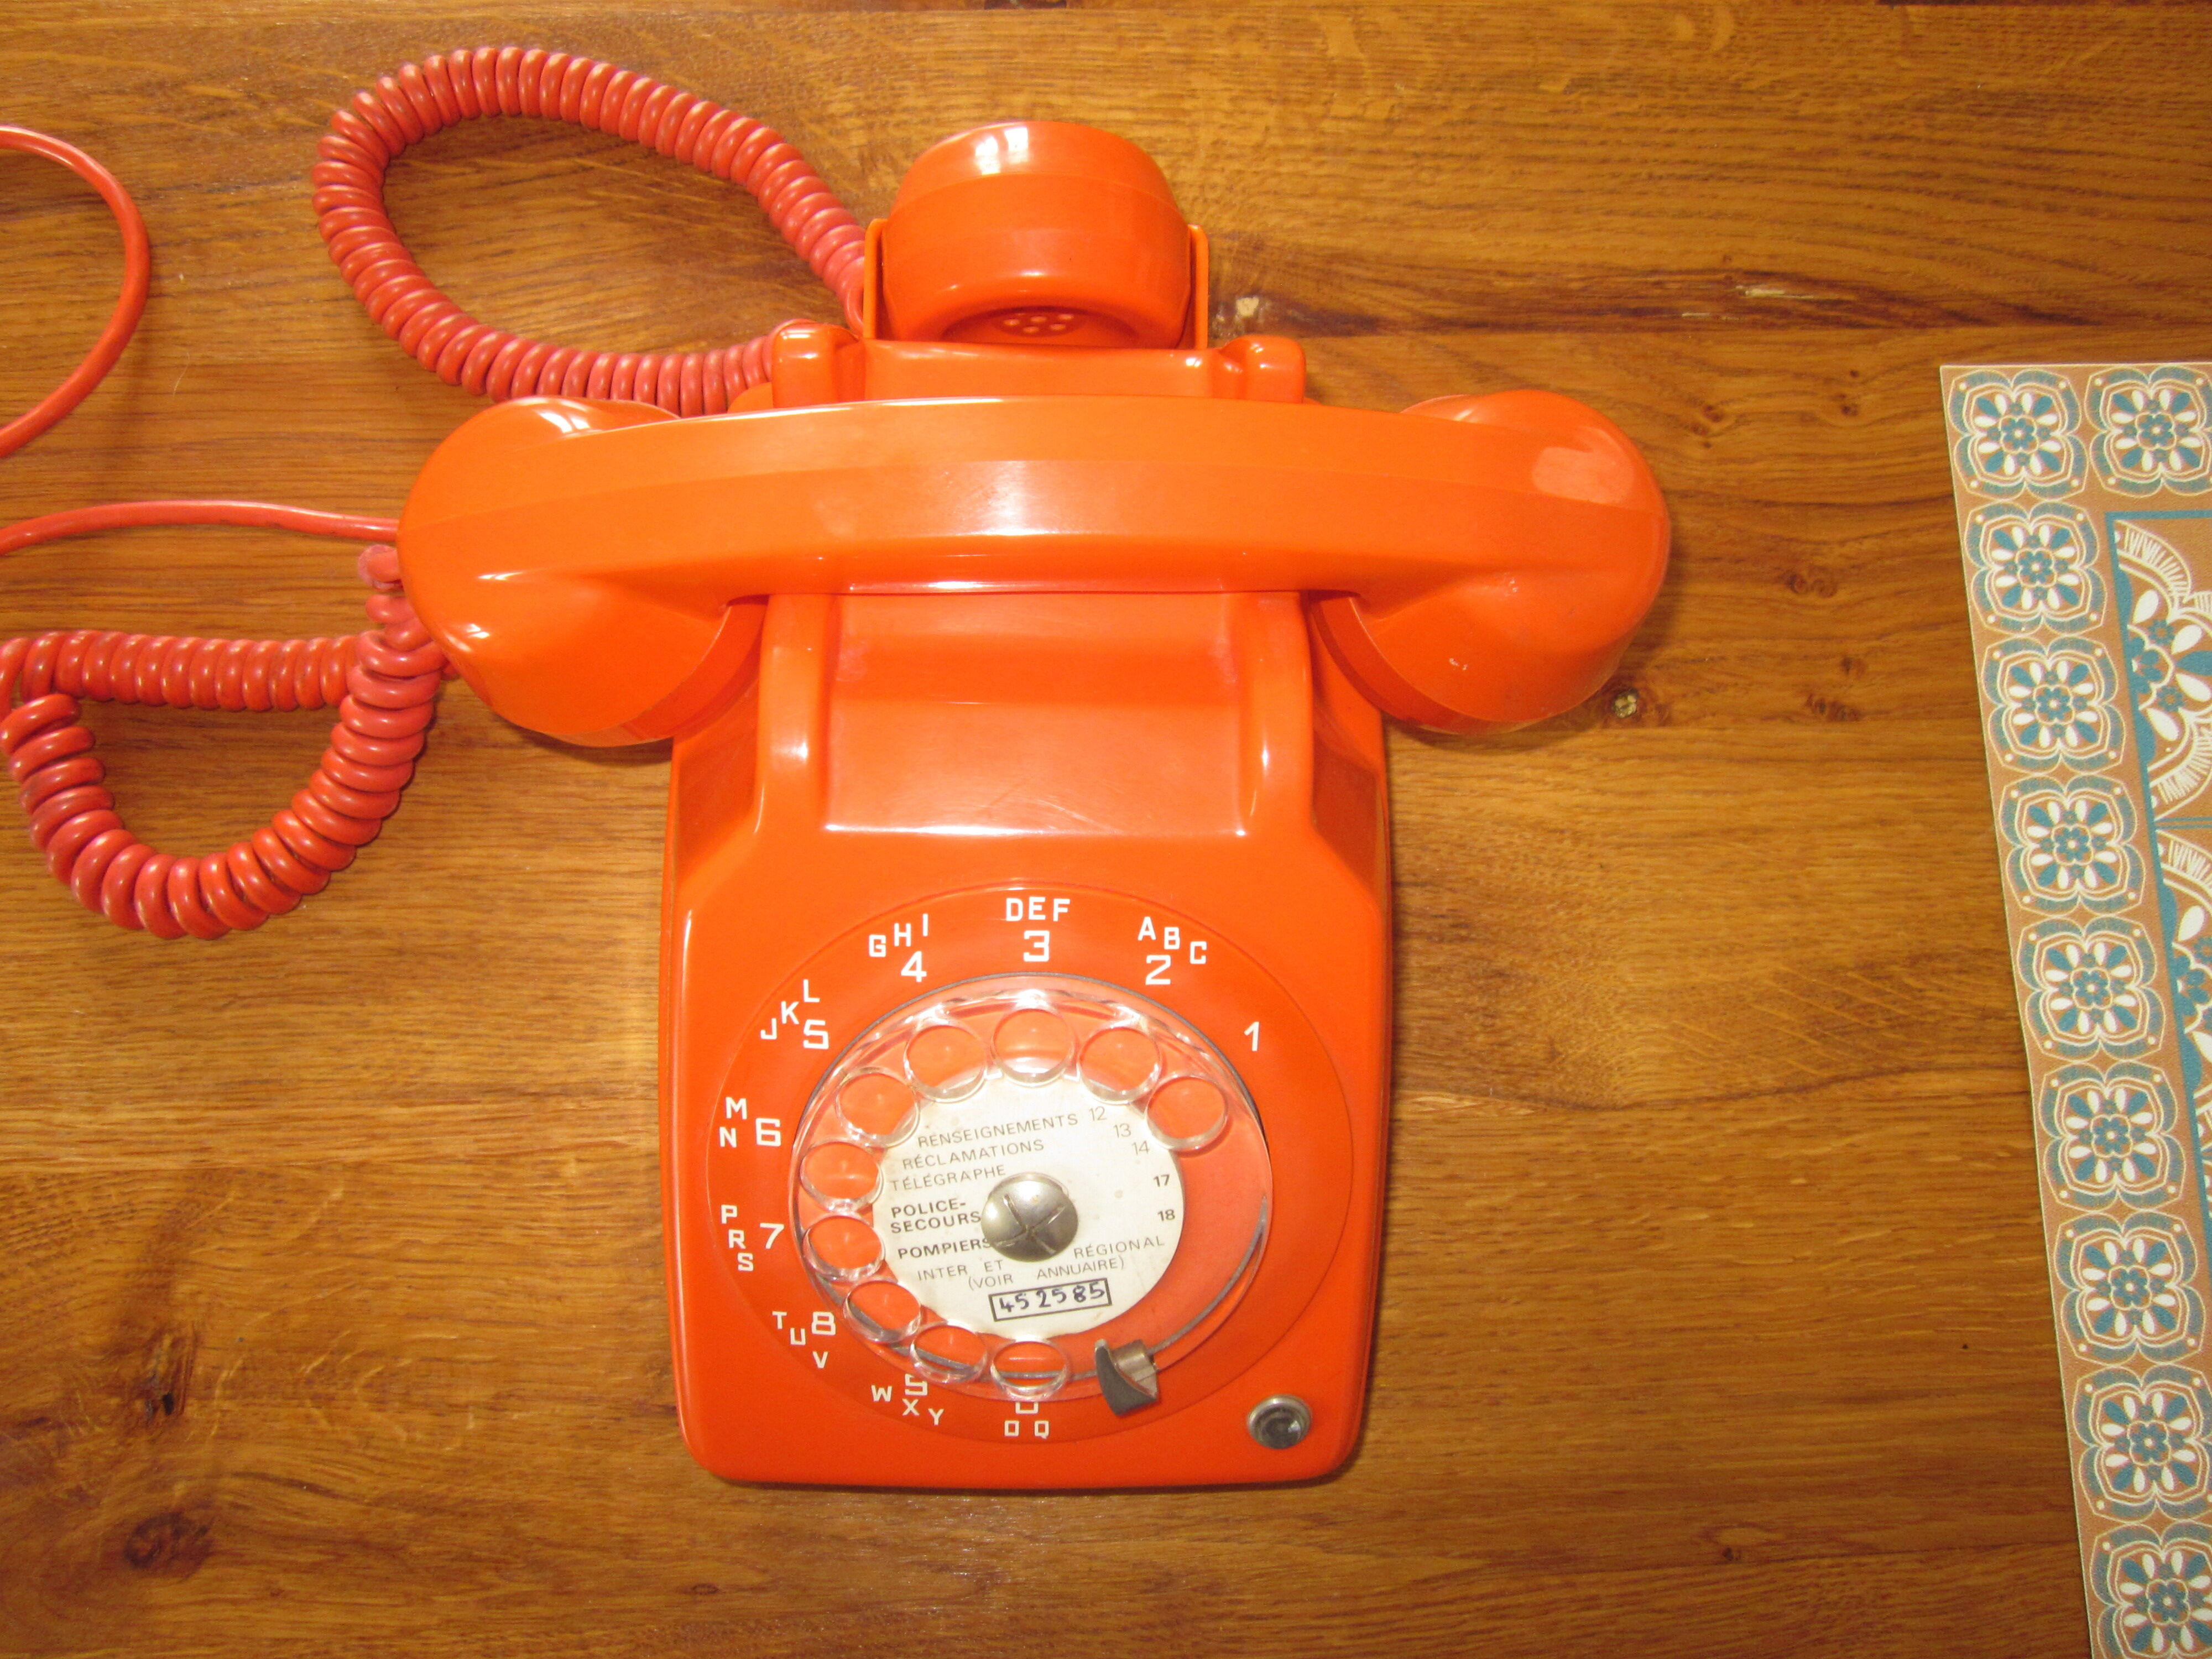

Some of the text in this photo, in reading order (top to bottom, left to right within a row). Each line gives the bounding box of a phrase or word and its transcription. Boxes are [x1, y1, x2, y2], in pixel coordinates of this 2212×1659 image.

[1005, 896, 1071, 922] DEF
[1022, 930, 1051, 963] 3
[900, 951, 928, 983] 4
[1145, 954, 1172, 986] 2
[802, 1019, 830, 1050] 5
[1244, 1021, 1260, 1052] 1
[755, 1118, 781, 1147] 6
[918, 1106, 1107, 1148] RENSEIGNEMENTS 12
[902, 1123, 1131, 1170] RÉCLAMATIONS 13
[889, 1140, 1150, 1191] TÉLÉGRAPHE 14
[1153, 1174, 1170, 1187] 17
[890, 1211, 982, 1234] SECOURS
[891, 1198, 966, 1218] POLICE-
[760, 1223, 785, 1250] 7
[898, 1209, 1176, 1259] POMPIERS 18
[917, 1236, 1165, 1281] INTER ET RÉGIONAL
[968, 1256, 1124, 1291] (VOIR ANNUAIRE)
[811, 1311, 836, 1336] 8
